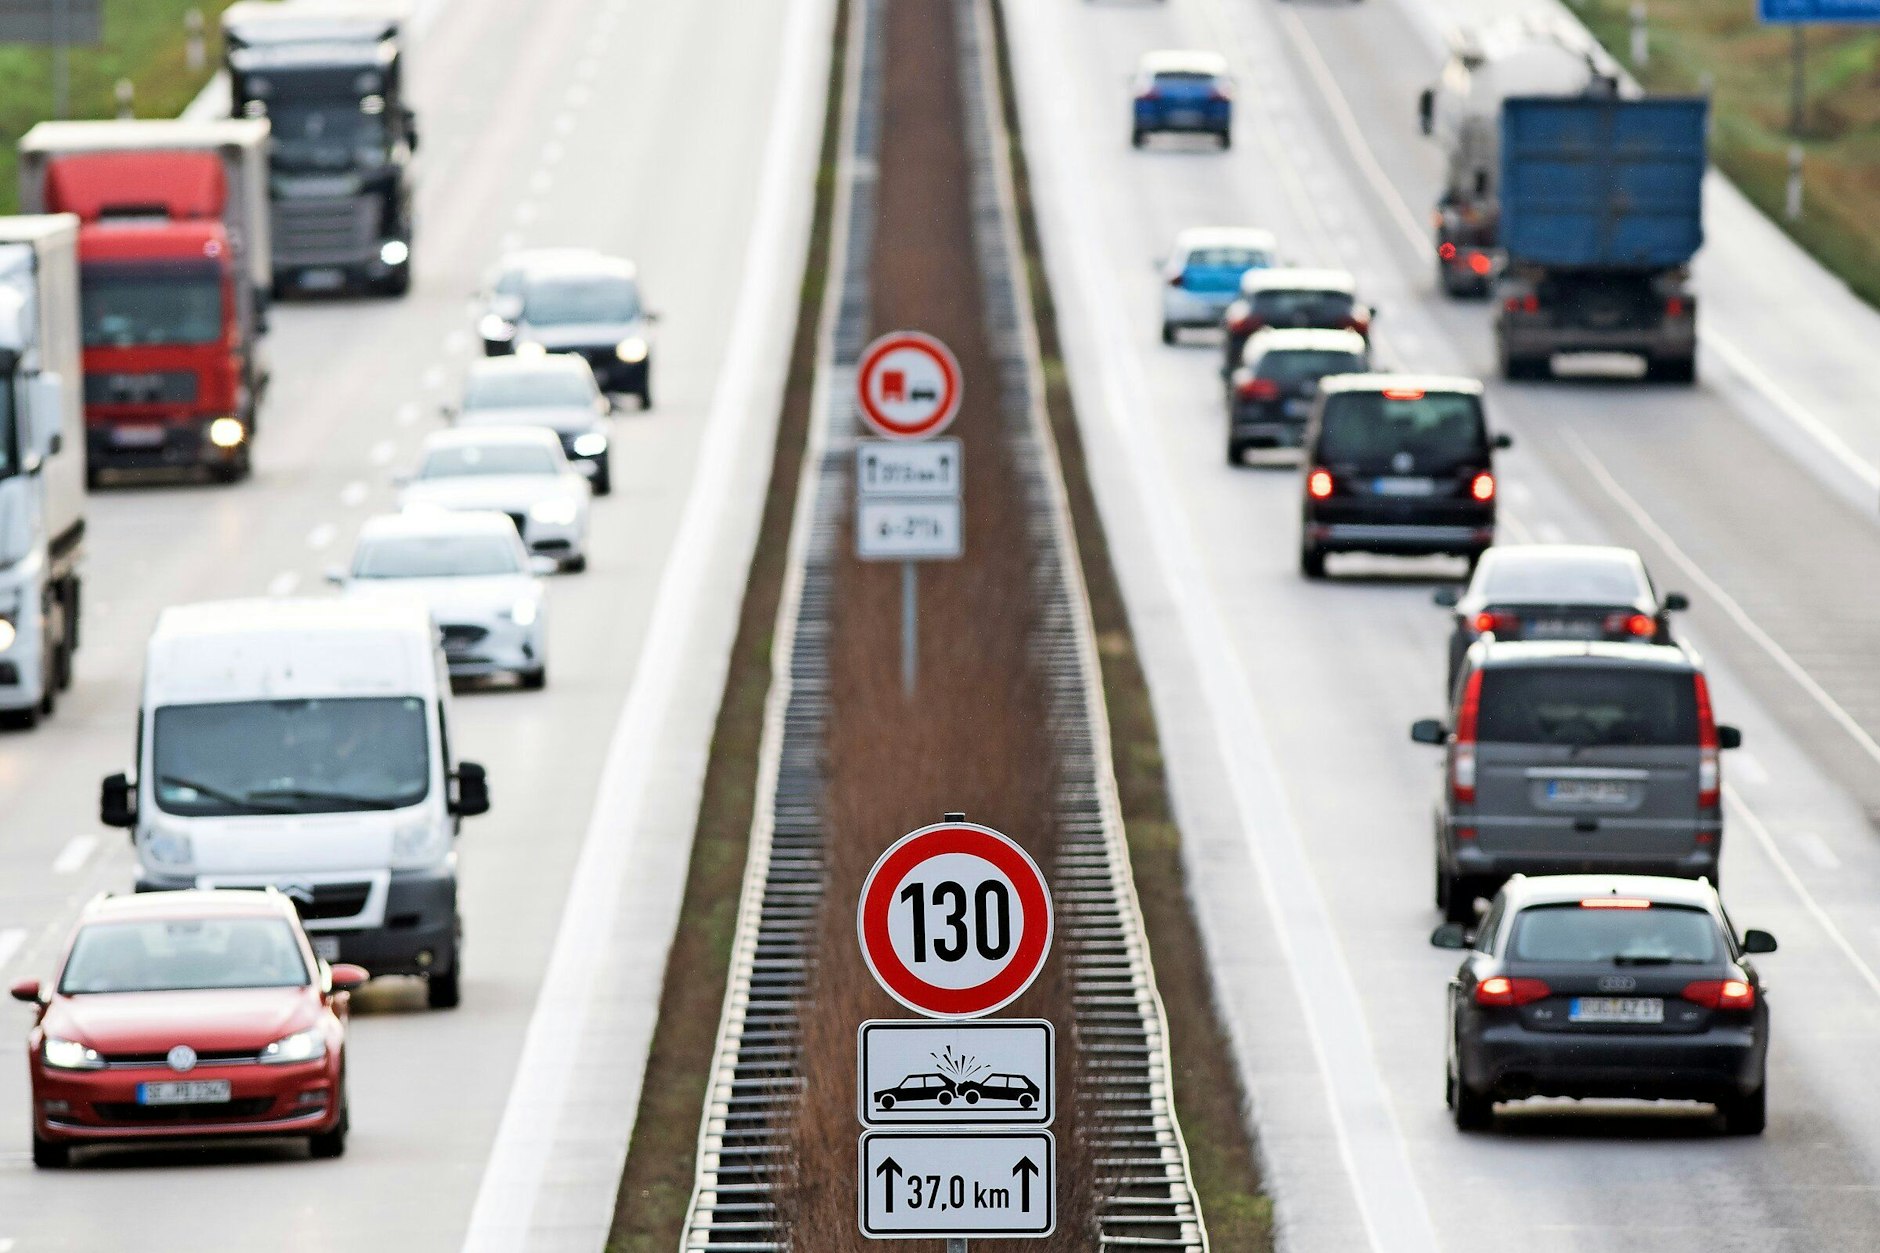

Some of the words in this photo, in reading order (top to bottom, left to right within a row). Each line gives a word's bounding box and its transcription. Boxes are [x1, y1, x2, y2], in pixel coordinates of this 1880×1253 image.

[901, 880, 1010, 963] 130
[907, 1174, 965, 1212] 37,0
[974, 1181, 1010, 1209] km
